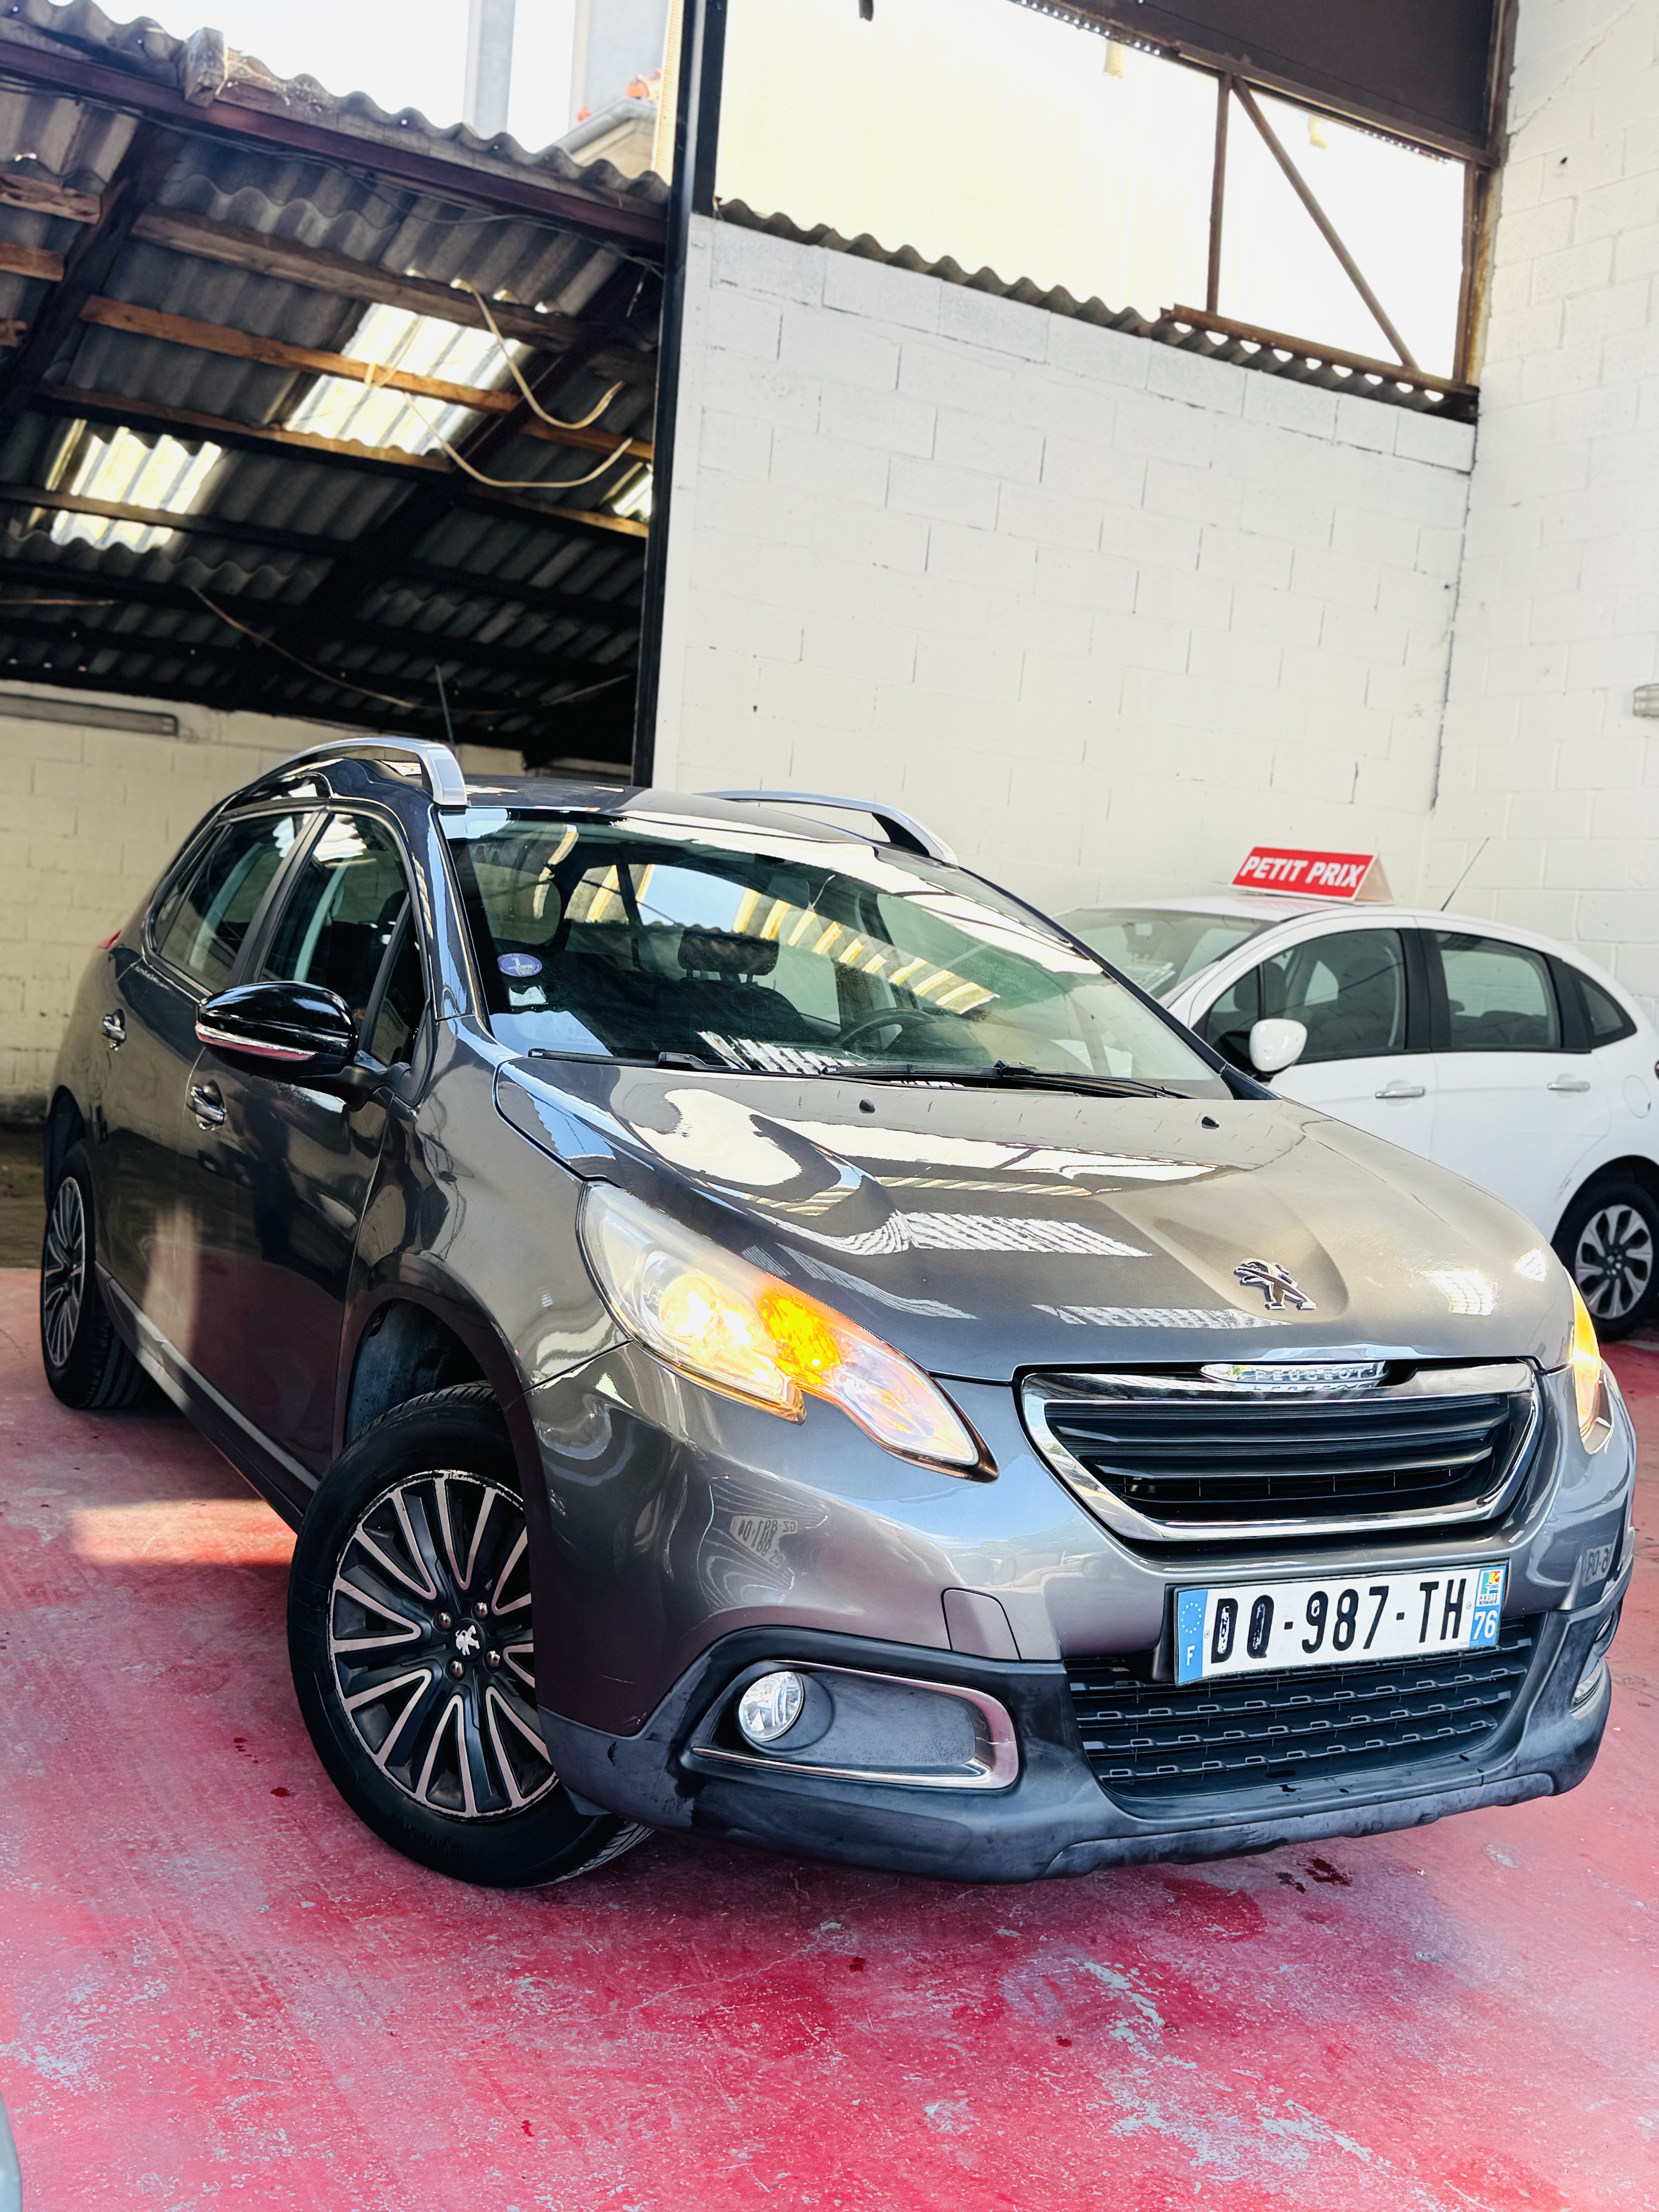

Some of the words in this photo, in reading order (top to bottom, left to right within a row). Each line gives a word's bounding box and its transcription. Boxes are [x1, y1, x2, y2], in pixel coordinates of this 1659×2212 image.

[1240, 856, 1309, 882] PETIT
[1306, 862, 1365, 888] PRIX
[1255, 1367, 1367, 1381] PEUGEOT
[1211, 1578, 1467, 1664] DQ-987-TH
[1473, 1610, 1498, 1640] 76
[1187, 1645, 1195, 1666] F
